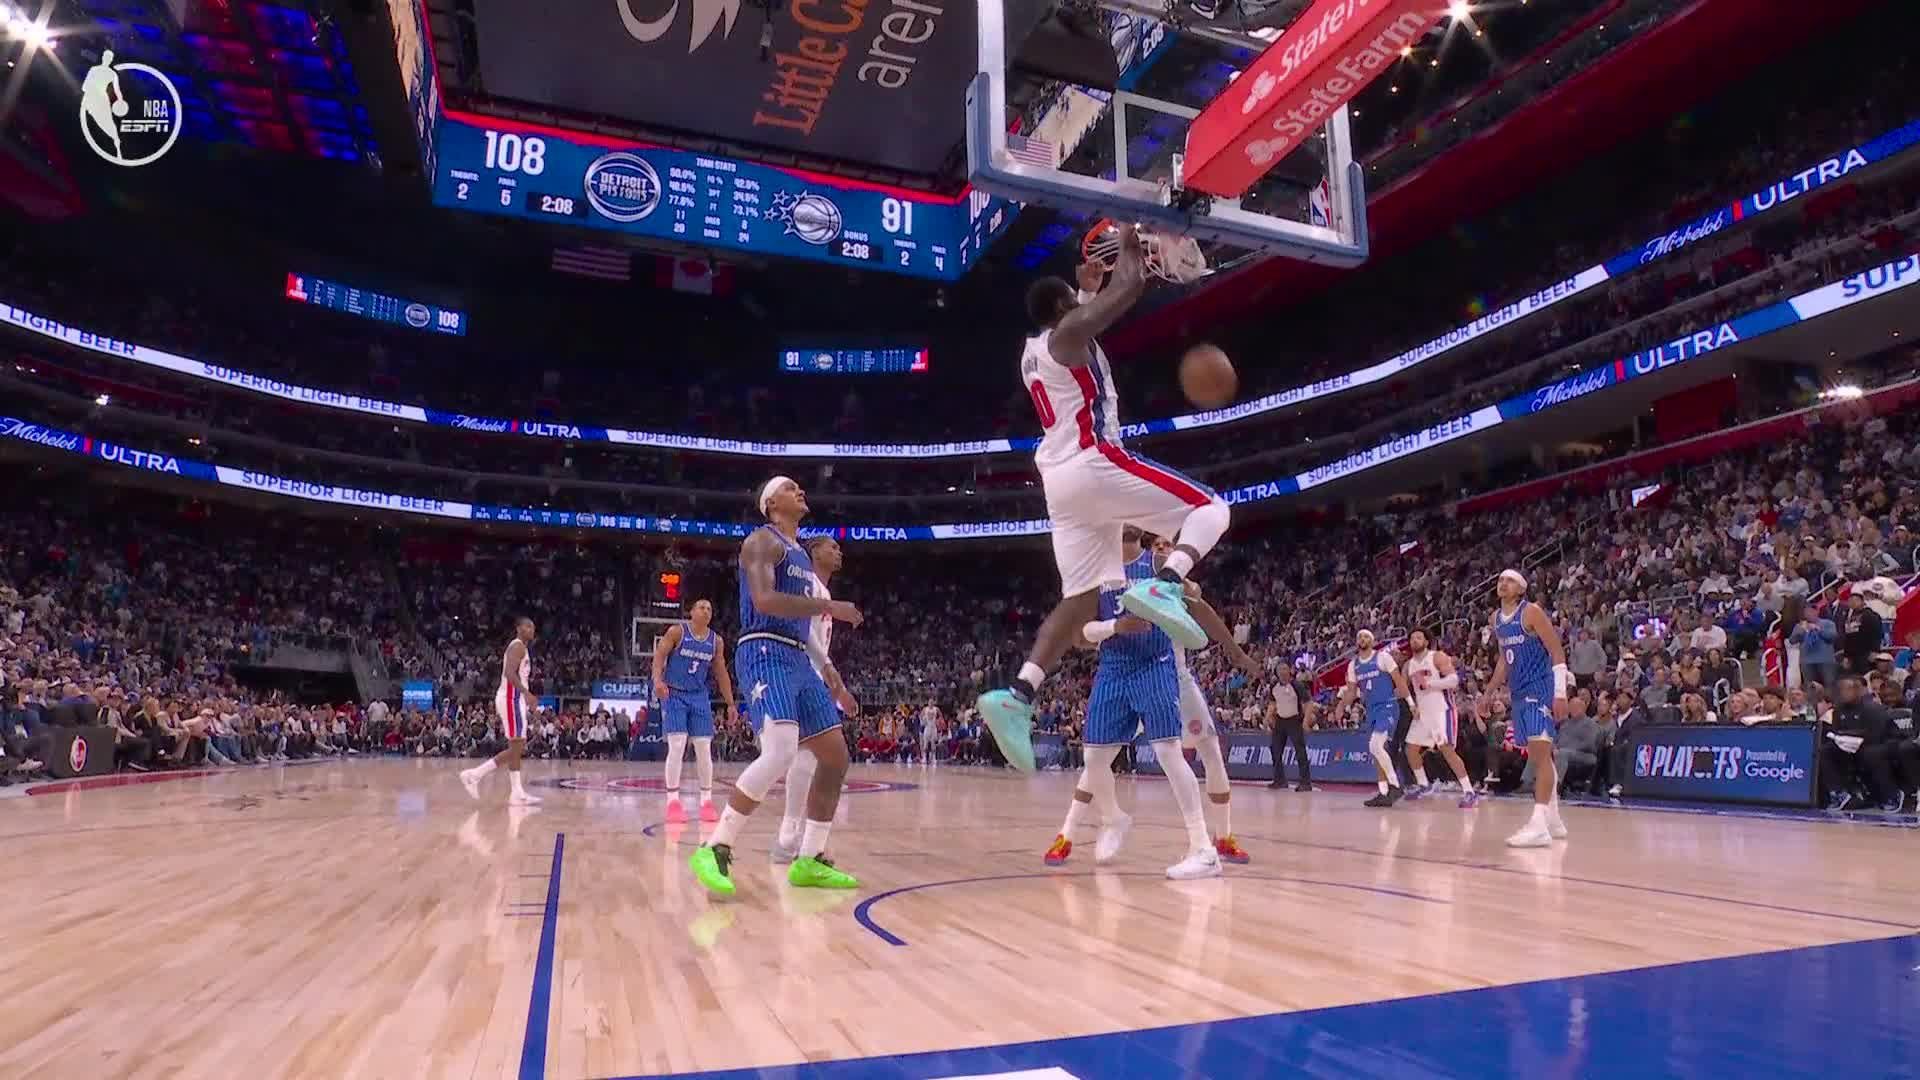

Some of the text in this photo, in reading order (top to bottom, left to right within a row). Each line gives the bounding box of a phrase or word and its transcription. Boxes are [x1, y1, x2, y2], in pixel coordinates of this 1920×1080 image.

[483, 130, 546, 176] 108
[600, 172, 650, 191] DETROIT
[457, 183, 469, 200] 2
[599, 184, 649, 202] PISTONS
[541, 195, 573, 215] 2:08
[1641, 149, 1868, 264] Michelob ULTRA
[881, 197, 912, 235] 91
[843, 230, 869, 243] BONUS
[842, 242, 870, 260] 2:08
[901, 251, 910, 266] 2
[935, 256, 944, 271] 4
[438, 310, 460, 329] 108
[1399, 277, 1577, 367] SUPERIOR LIGHT BEER
[9, 306, 137, 356] LIGHT BEER
[1531, 323, 1738, 412] Michelob ULTRA
[203, 363, 403, 415] SUPERIOR LIGHT BEER
[1191, 375, 1352, 424] SUPERIOR LIGHT BEER
[523, 421, 582, 439] ULTRA
[1119, 422, 1150, 440] TRA
[626, 430, 788, 453] SUPERIOR LIGHT BEER
[833, 440, 991, 455] SUPERIOR LIGHT BEER
[1308, 415, 1473, 484] SUPERIOR LIGHT BEER
[100, 442, 181, 475] ULTRA
[241, 470, 445, 513] SUPERIOR LIGHT BEER
[851, 527, 908, 541] ULTRA
[952, 520, 1029, 535] SUPERIOR
[1505, 648, 1514, 665] 0
[1744, 763, 1804, 782] Google
